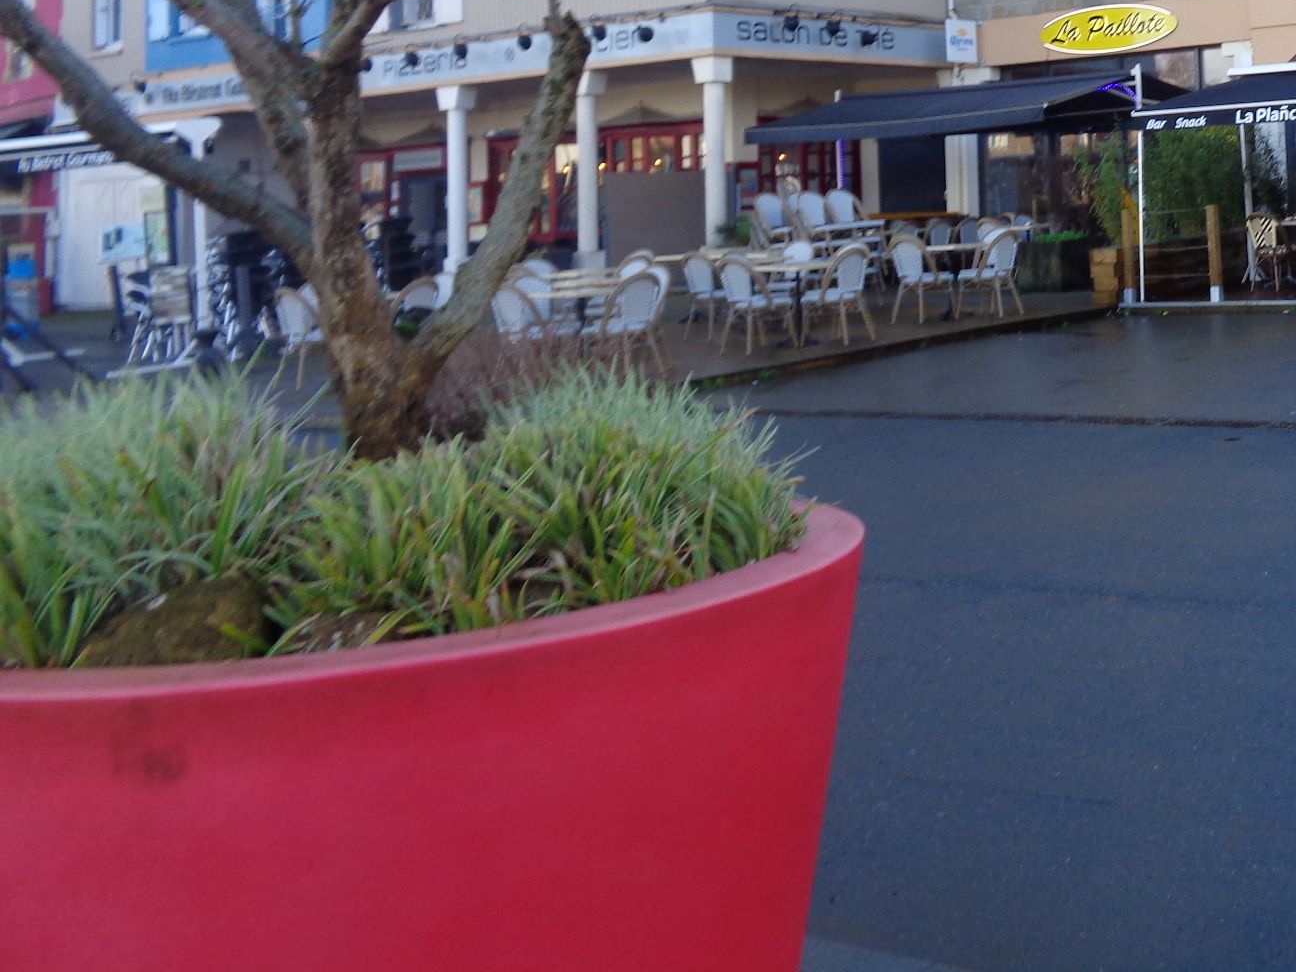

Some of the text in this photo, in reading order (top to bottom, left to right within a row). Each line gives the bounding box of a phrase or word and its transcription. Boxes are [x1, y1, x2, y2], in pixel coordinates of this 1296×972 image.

[1050, 11, 1166, 44] La Paillote
[1146, 118, 1168, 130] Bar
[1174, 115, 1208, 129] Snack
[1235, 109, 1254, 125] La
